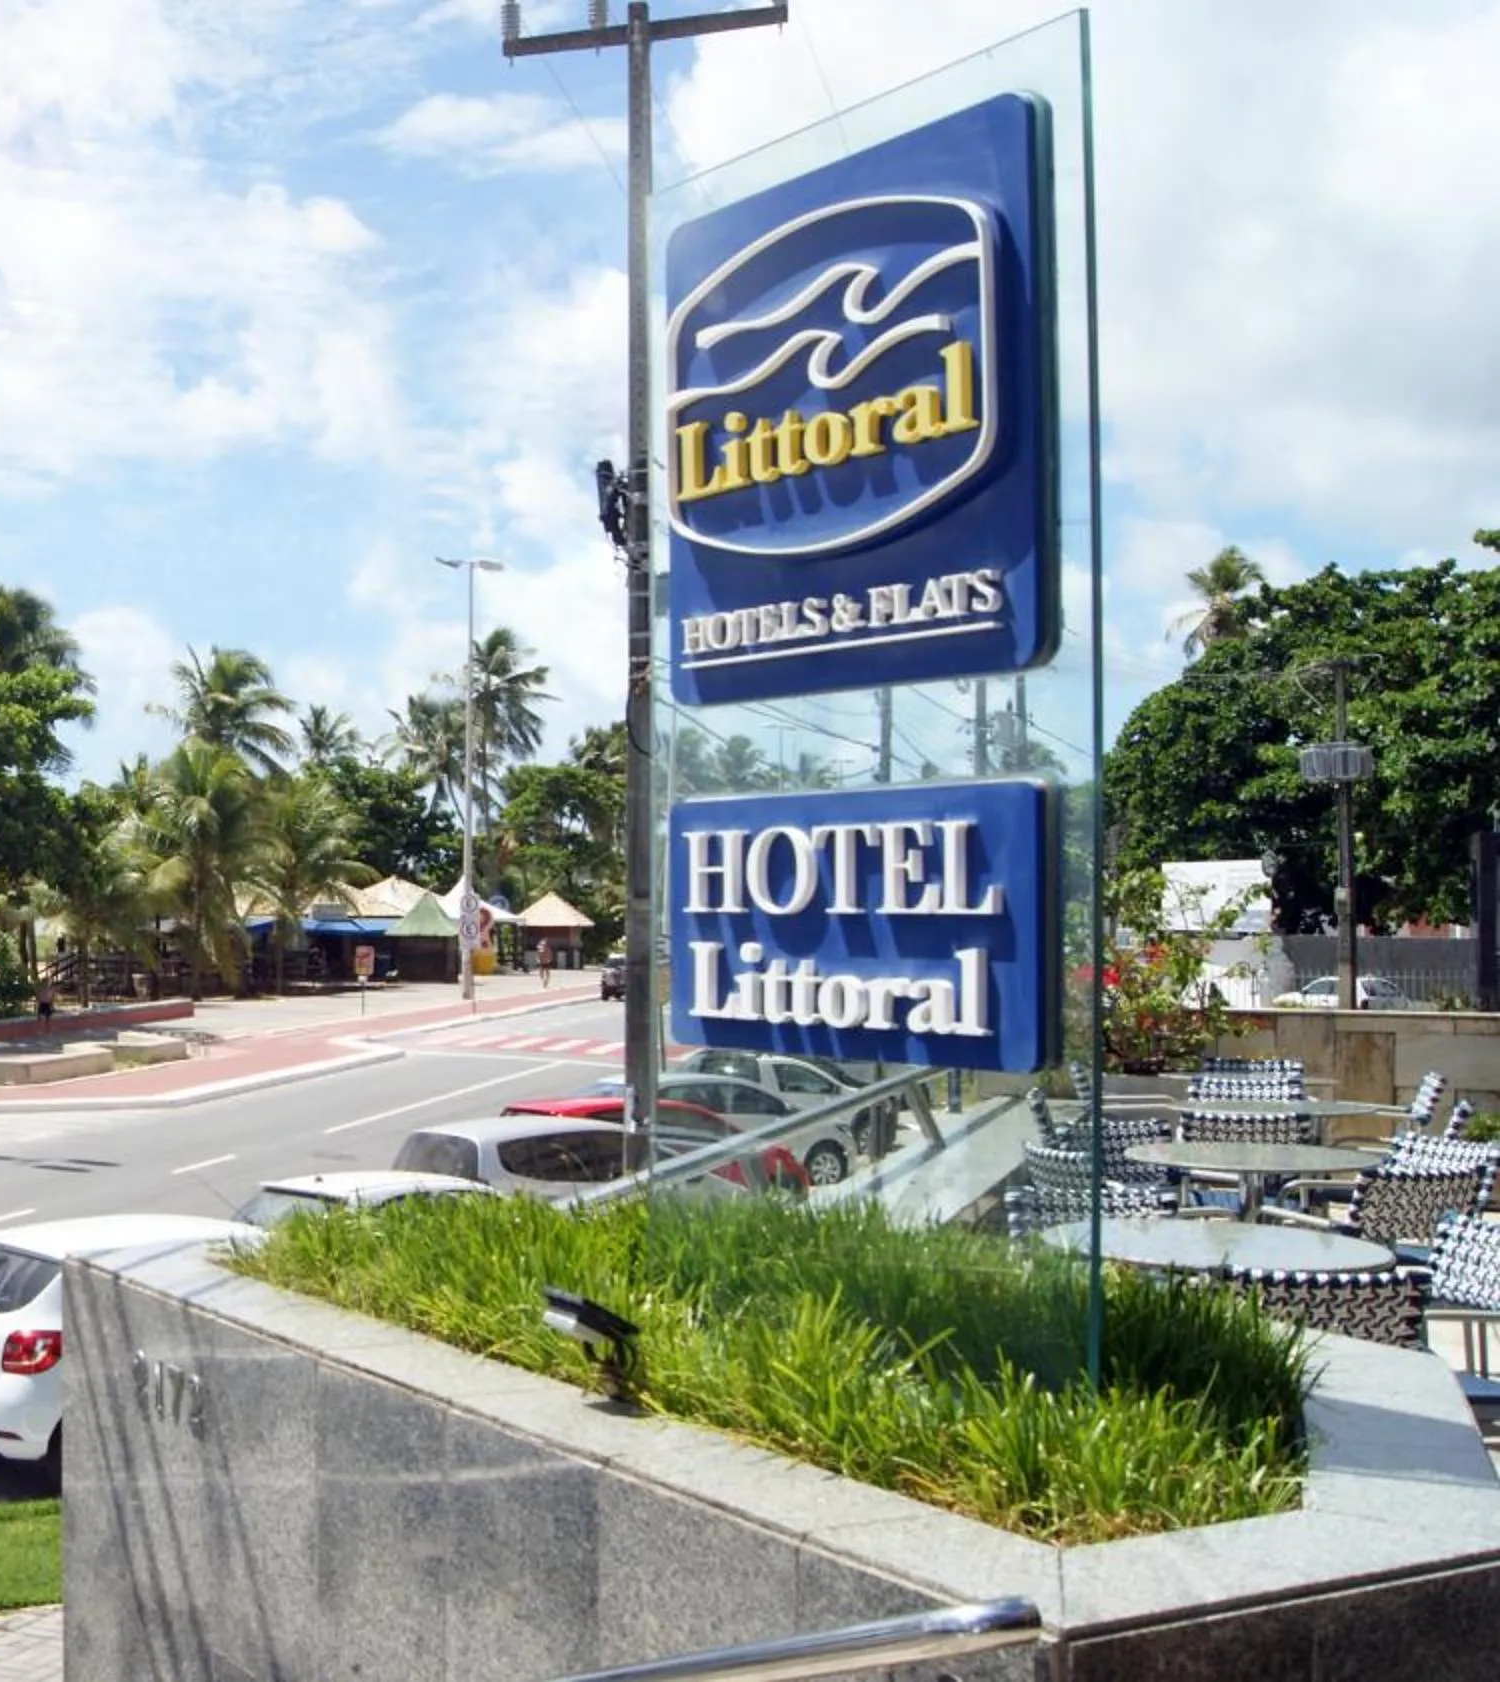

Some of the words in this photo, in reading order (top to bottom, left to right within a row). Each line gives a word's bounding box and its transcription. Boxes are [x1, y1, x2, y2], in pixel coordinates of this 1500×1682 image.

[675, 340, 980, 502] Littoral
[680, 597, 830, 655] HOTELS
[831, 592, 867, 632] &
[866, 567, 1003, 628] FLATS
[682, 817, 1005, 916] HOTEL
[688, 941, 995, 1037] Littoral
